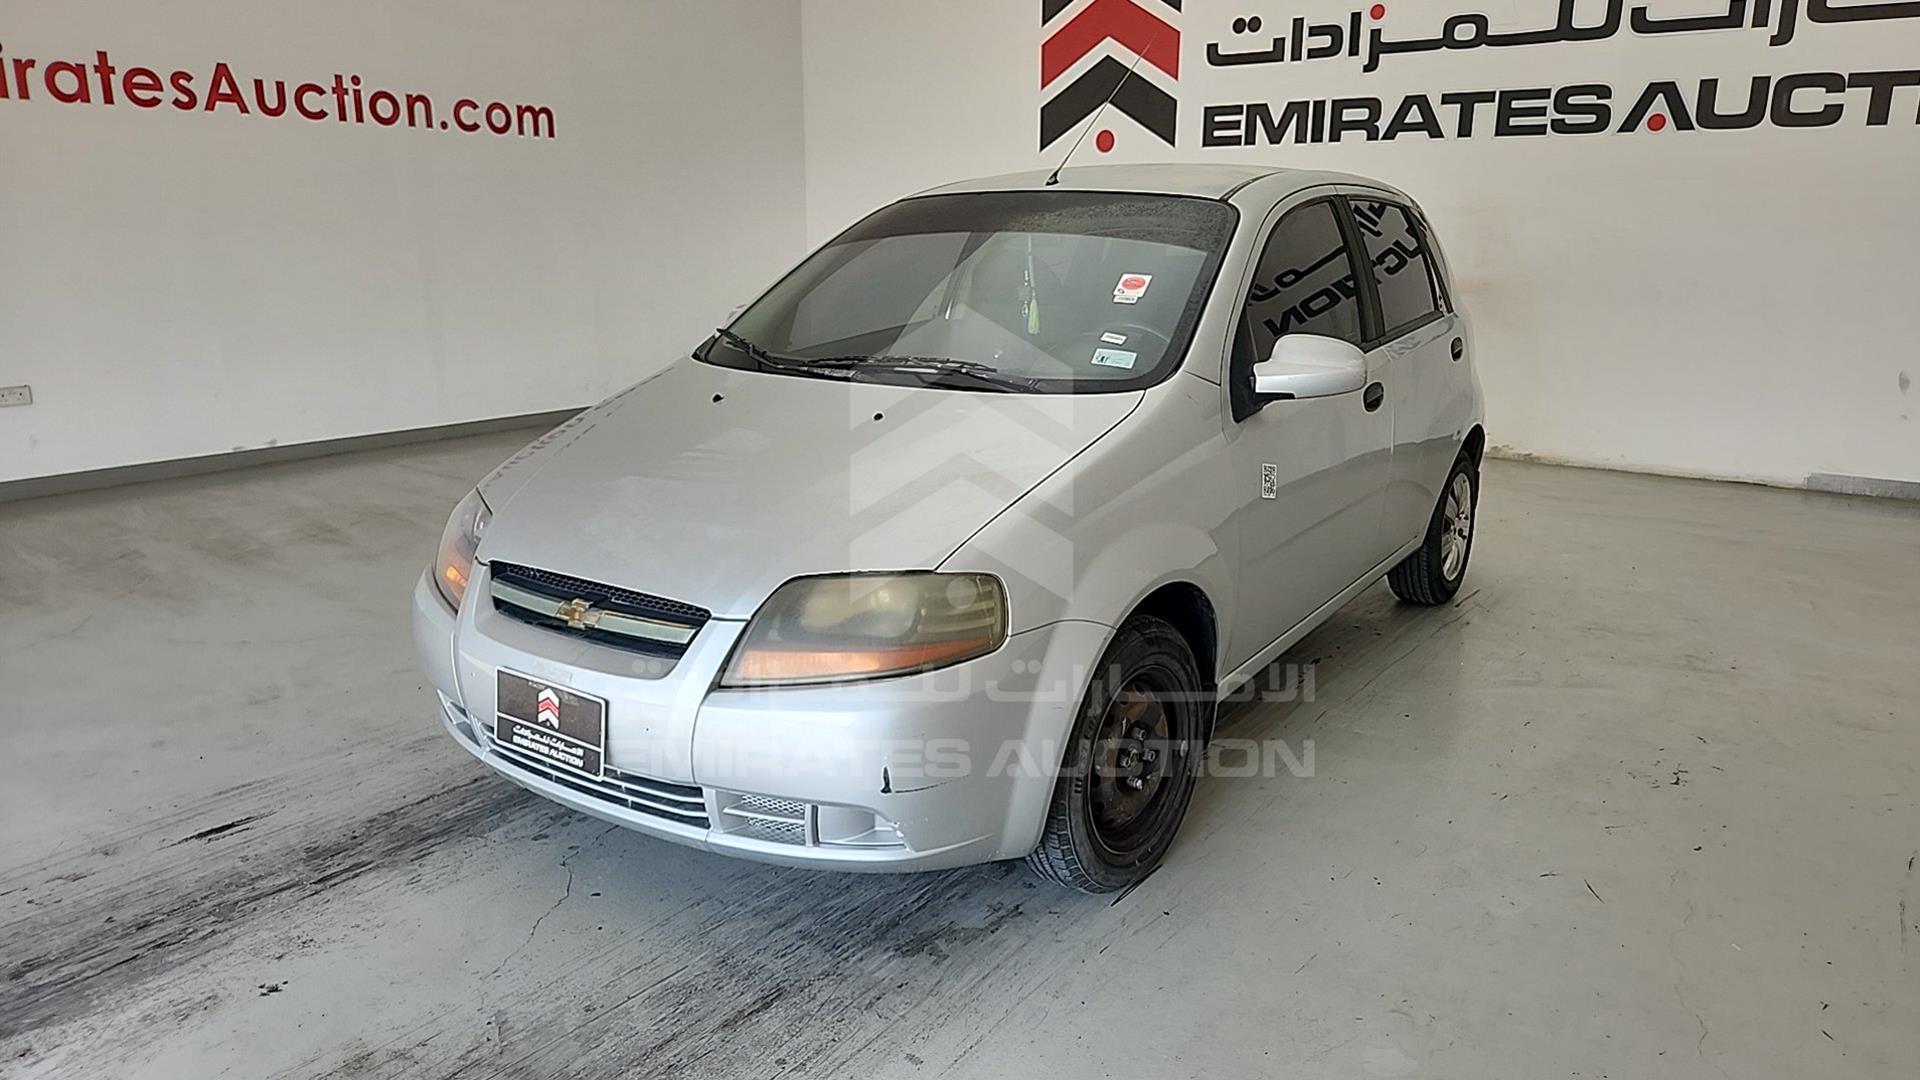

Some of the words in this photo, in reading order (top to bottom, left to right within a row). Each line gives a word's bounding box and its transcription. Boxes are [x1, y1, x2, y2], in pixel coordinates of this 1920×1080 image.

[1202, 83, 1612, 147] EMIRATES
[1616, 70, 1920, 133] AUCT
[549, 748, 584, 767] AUCTION
